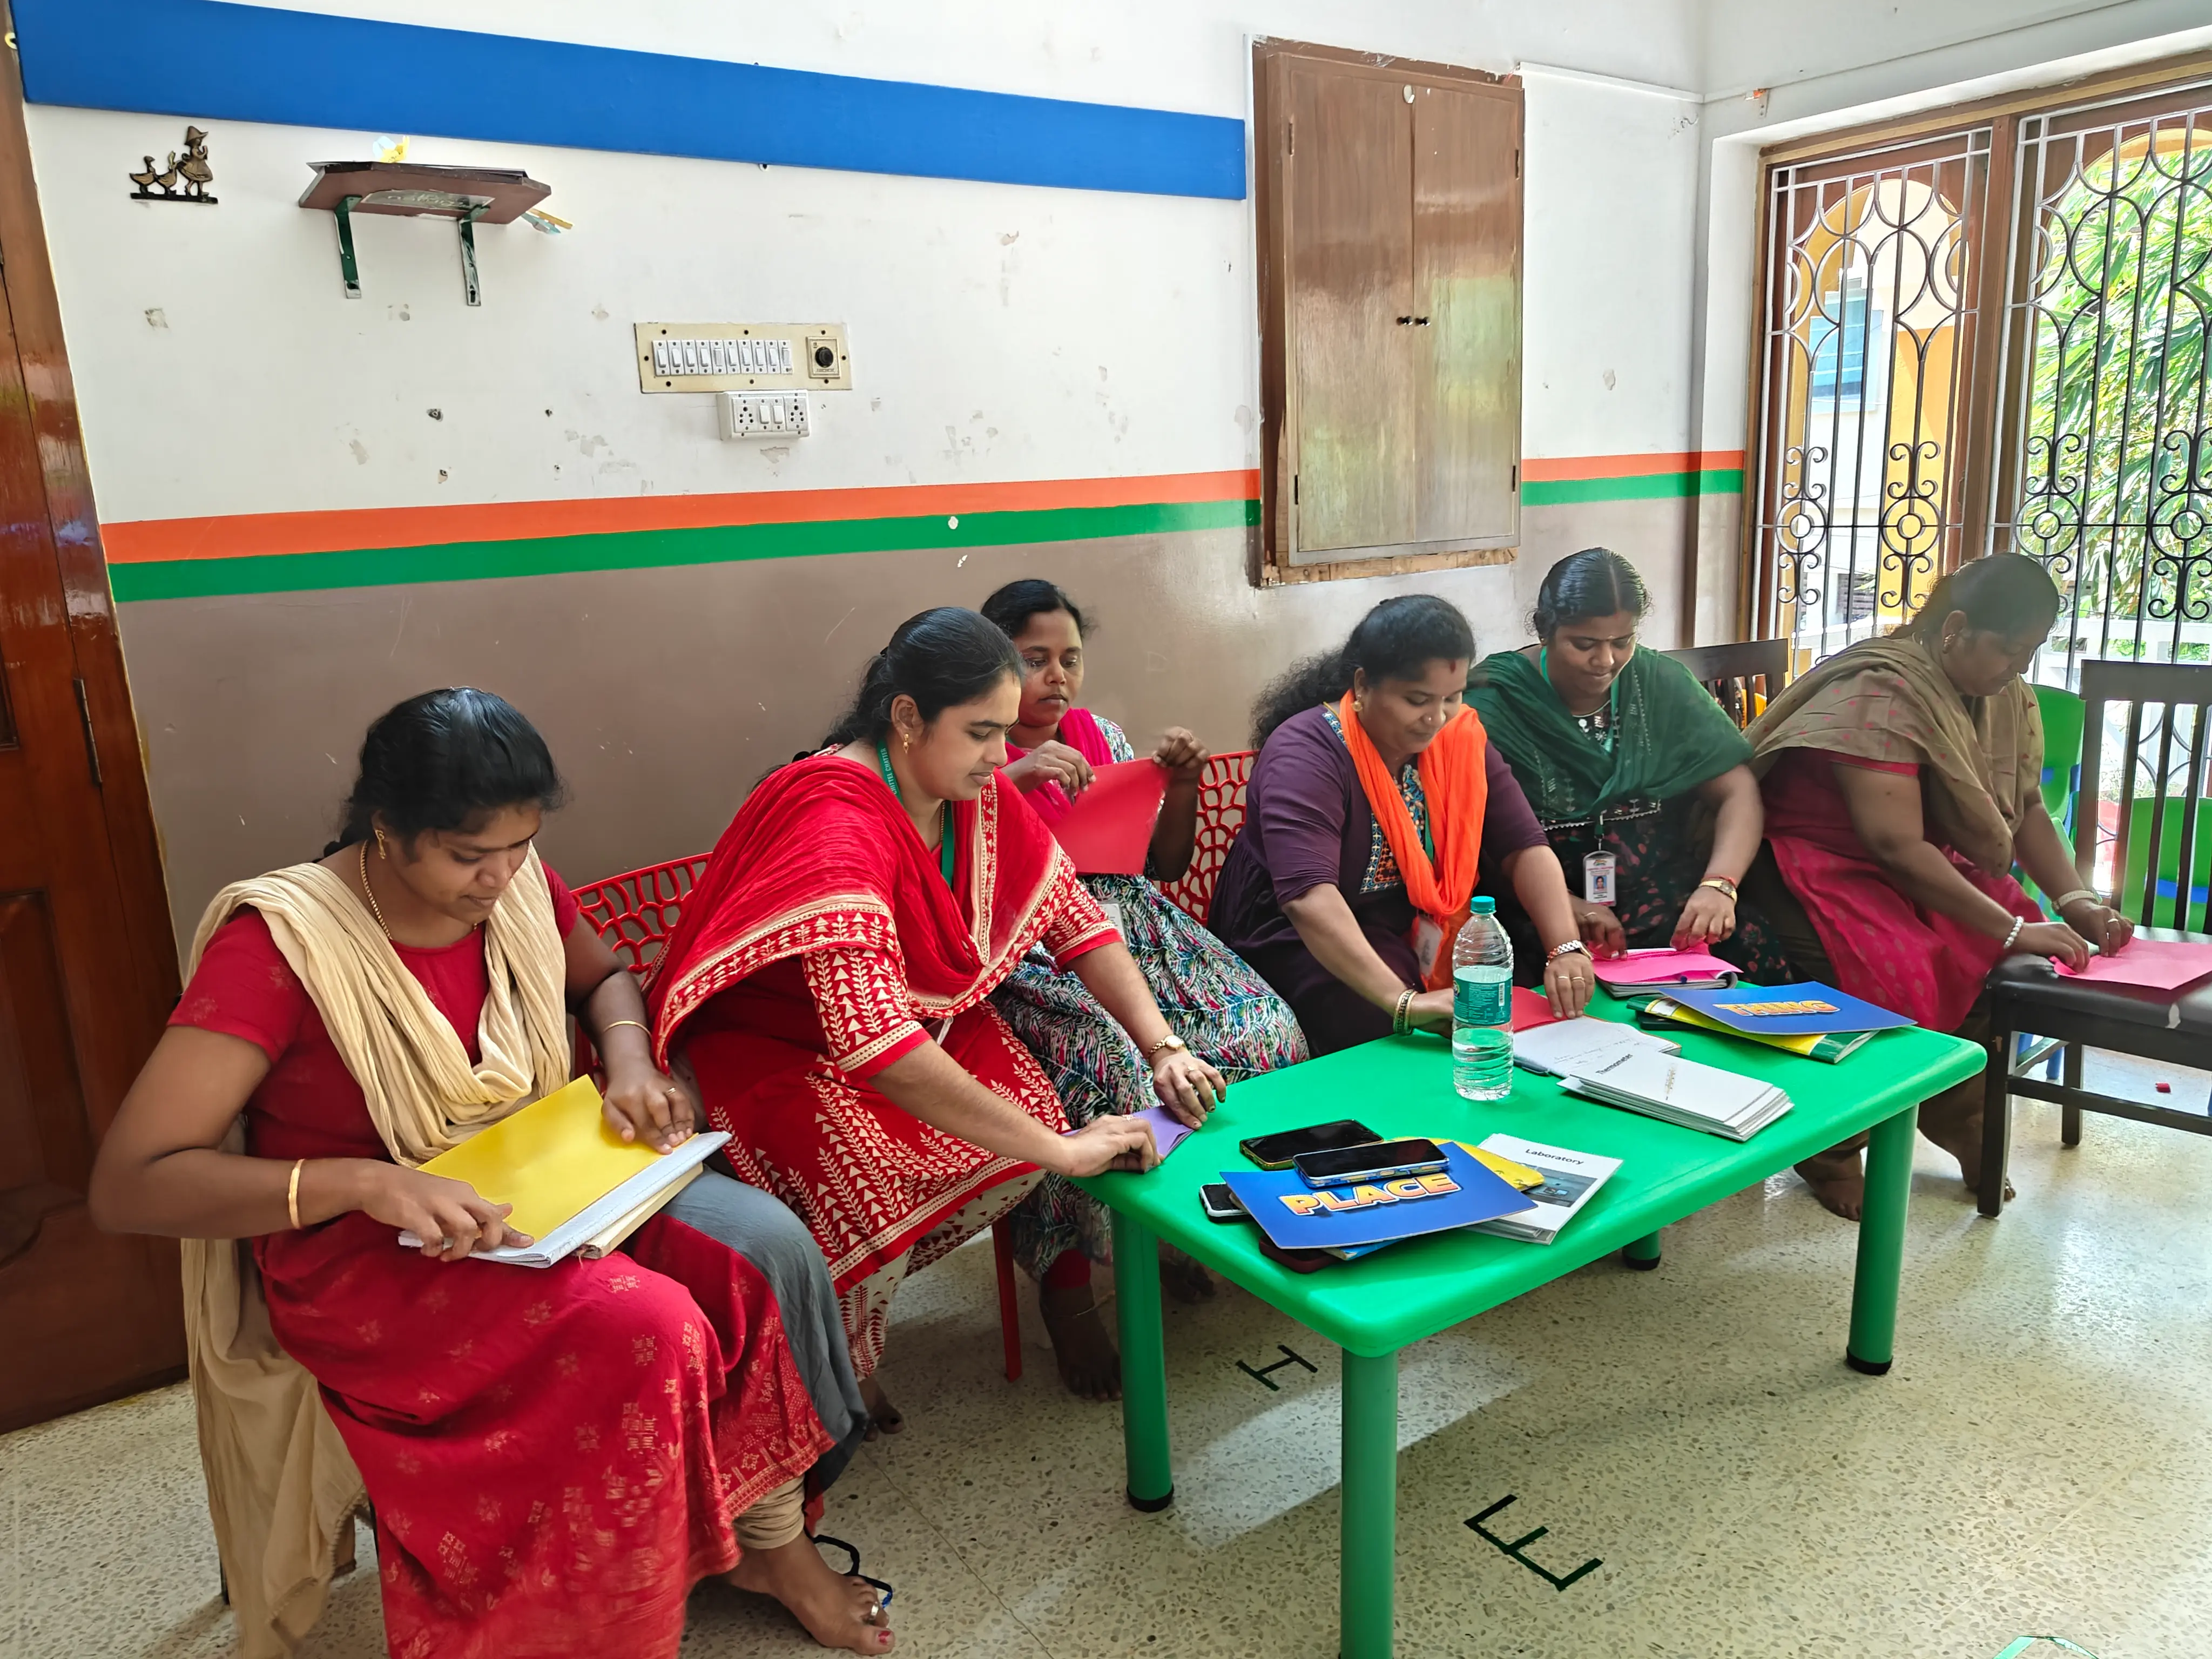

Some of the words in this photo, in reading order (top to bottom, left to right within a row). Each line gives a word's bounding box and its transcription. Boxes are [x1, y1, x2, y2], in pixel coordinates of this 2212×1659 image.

[880, 748, 892, 771] CHATTER
[1712, 1000, 1840, 1016] THING
[1595, 1054, 1633, 1075] Thermometer
[1525, 1149, 1584, 1165] Laboratory
[1278, 1172, 1461, 1216] PLACE
[1236, 1344, 1318, 1391] H
[1463, 1494, 1603, 1591] E
